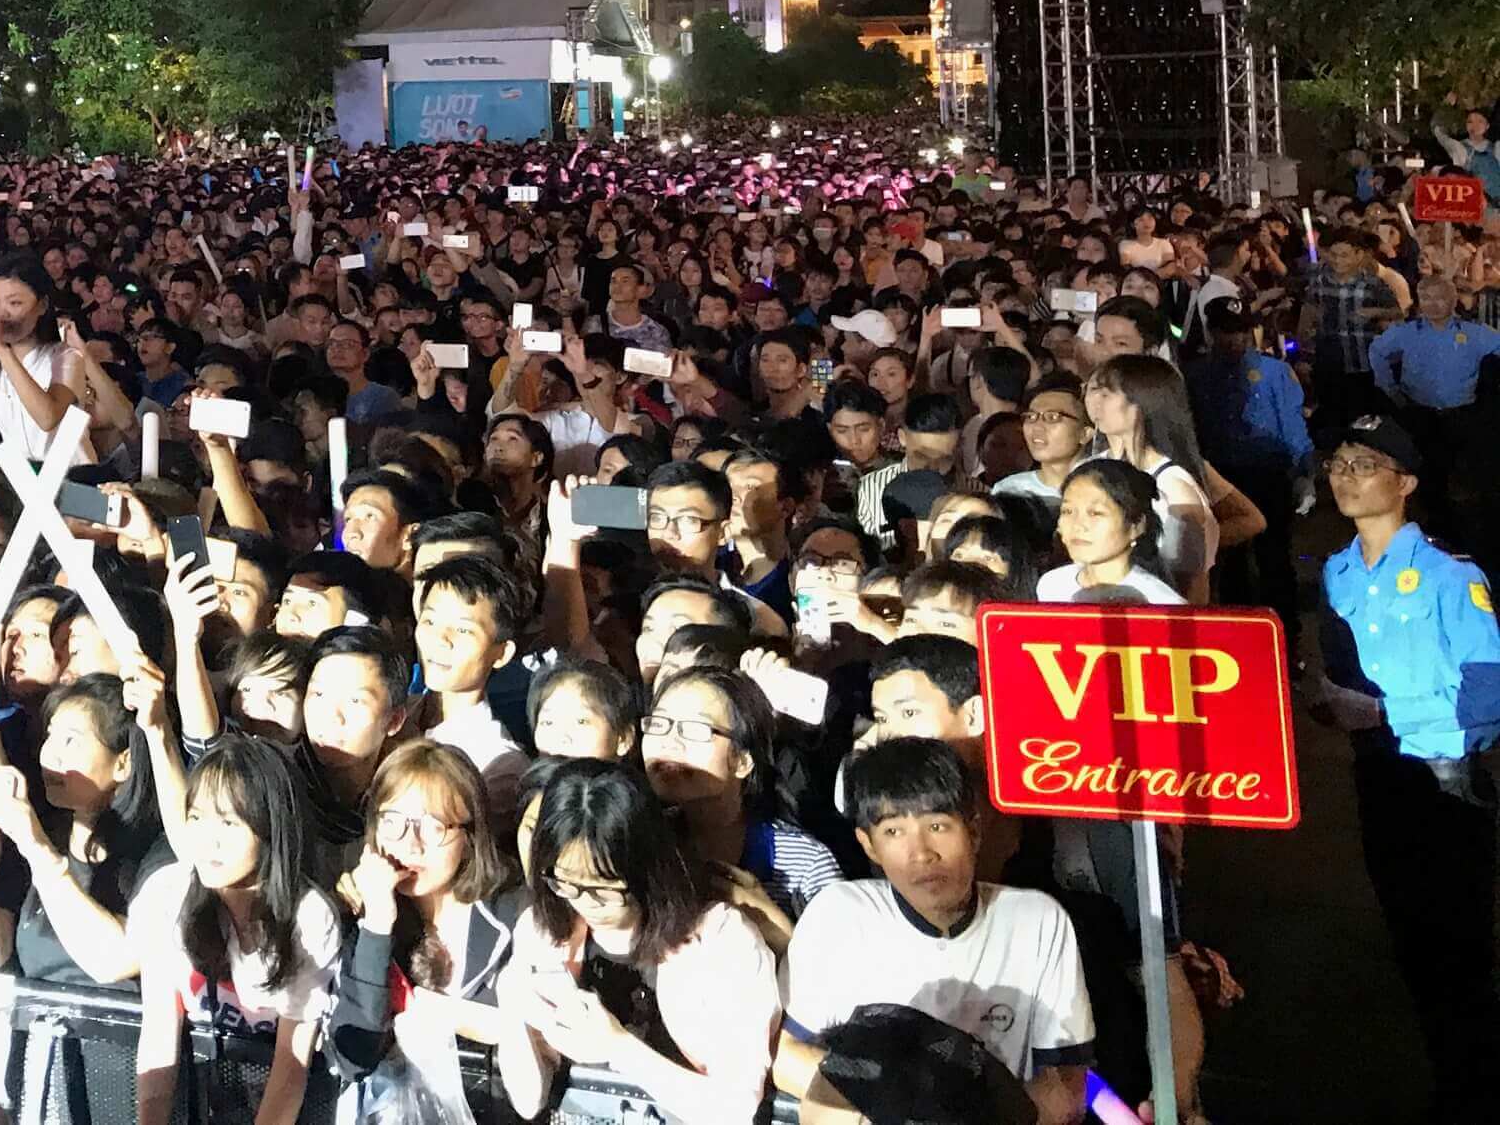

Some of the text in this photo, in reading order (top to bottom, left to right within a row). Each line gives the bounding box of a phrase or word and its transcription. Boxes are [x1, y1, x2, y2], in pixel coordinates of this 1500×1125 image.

[1426, 183, 1474, 203] VIP
[1021, 643, 1240, 724] VIP
[1019, 738, 1261, 801] Entrance
